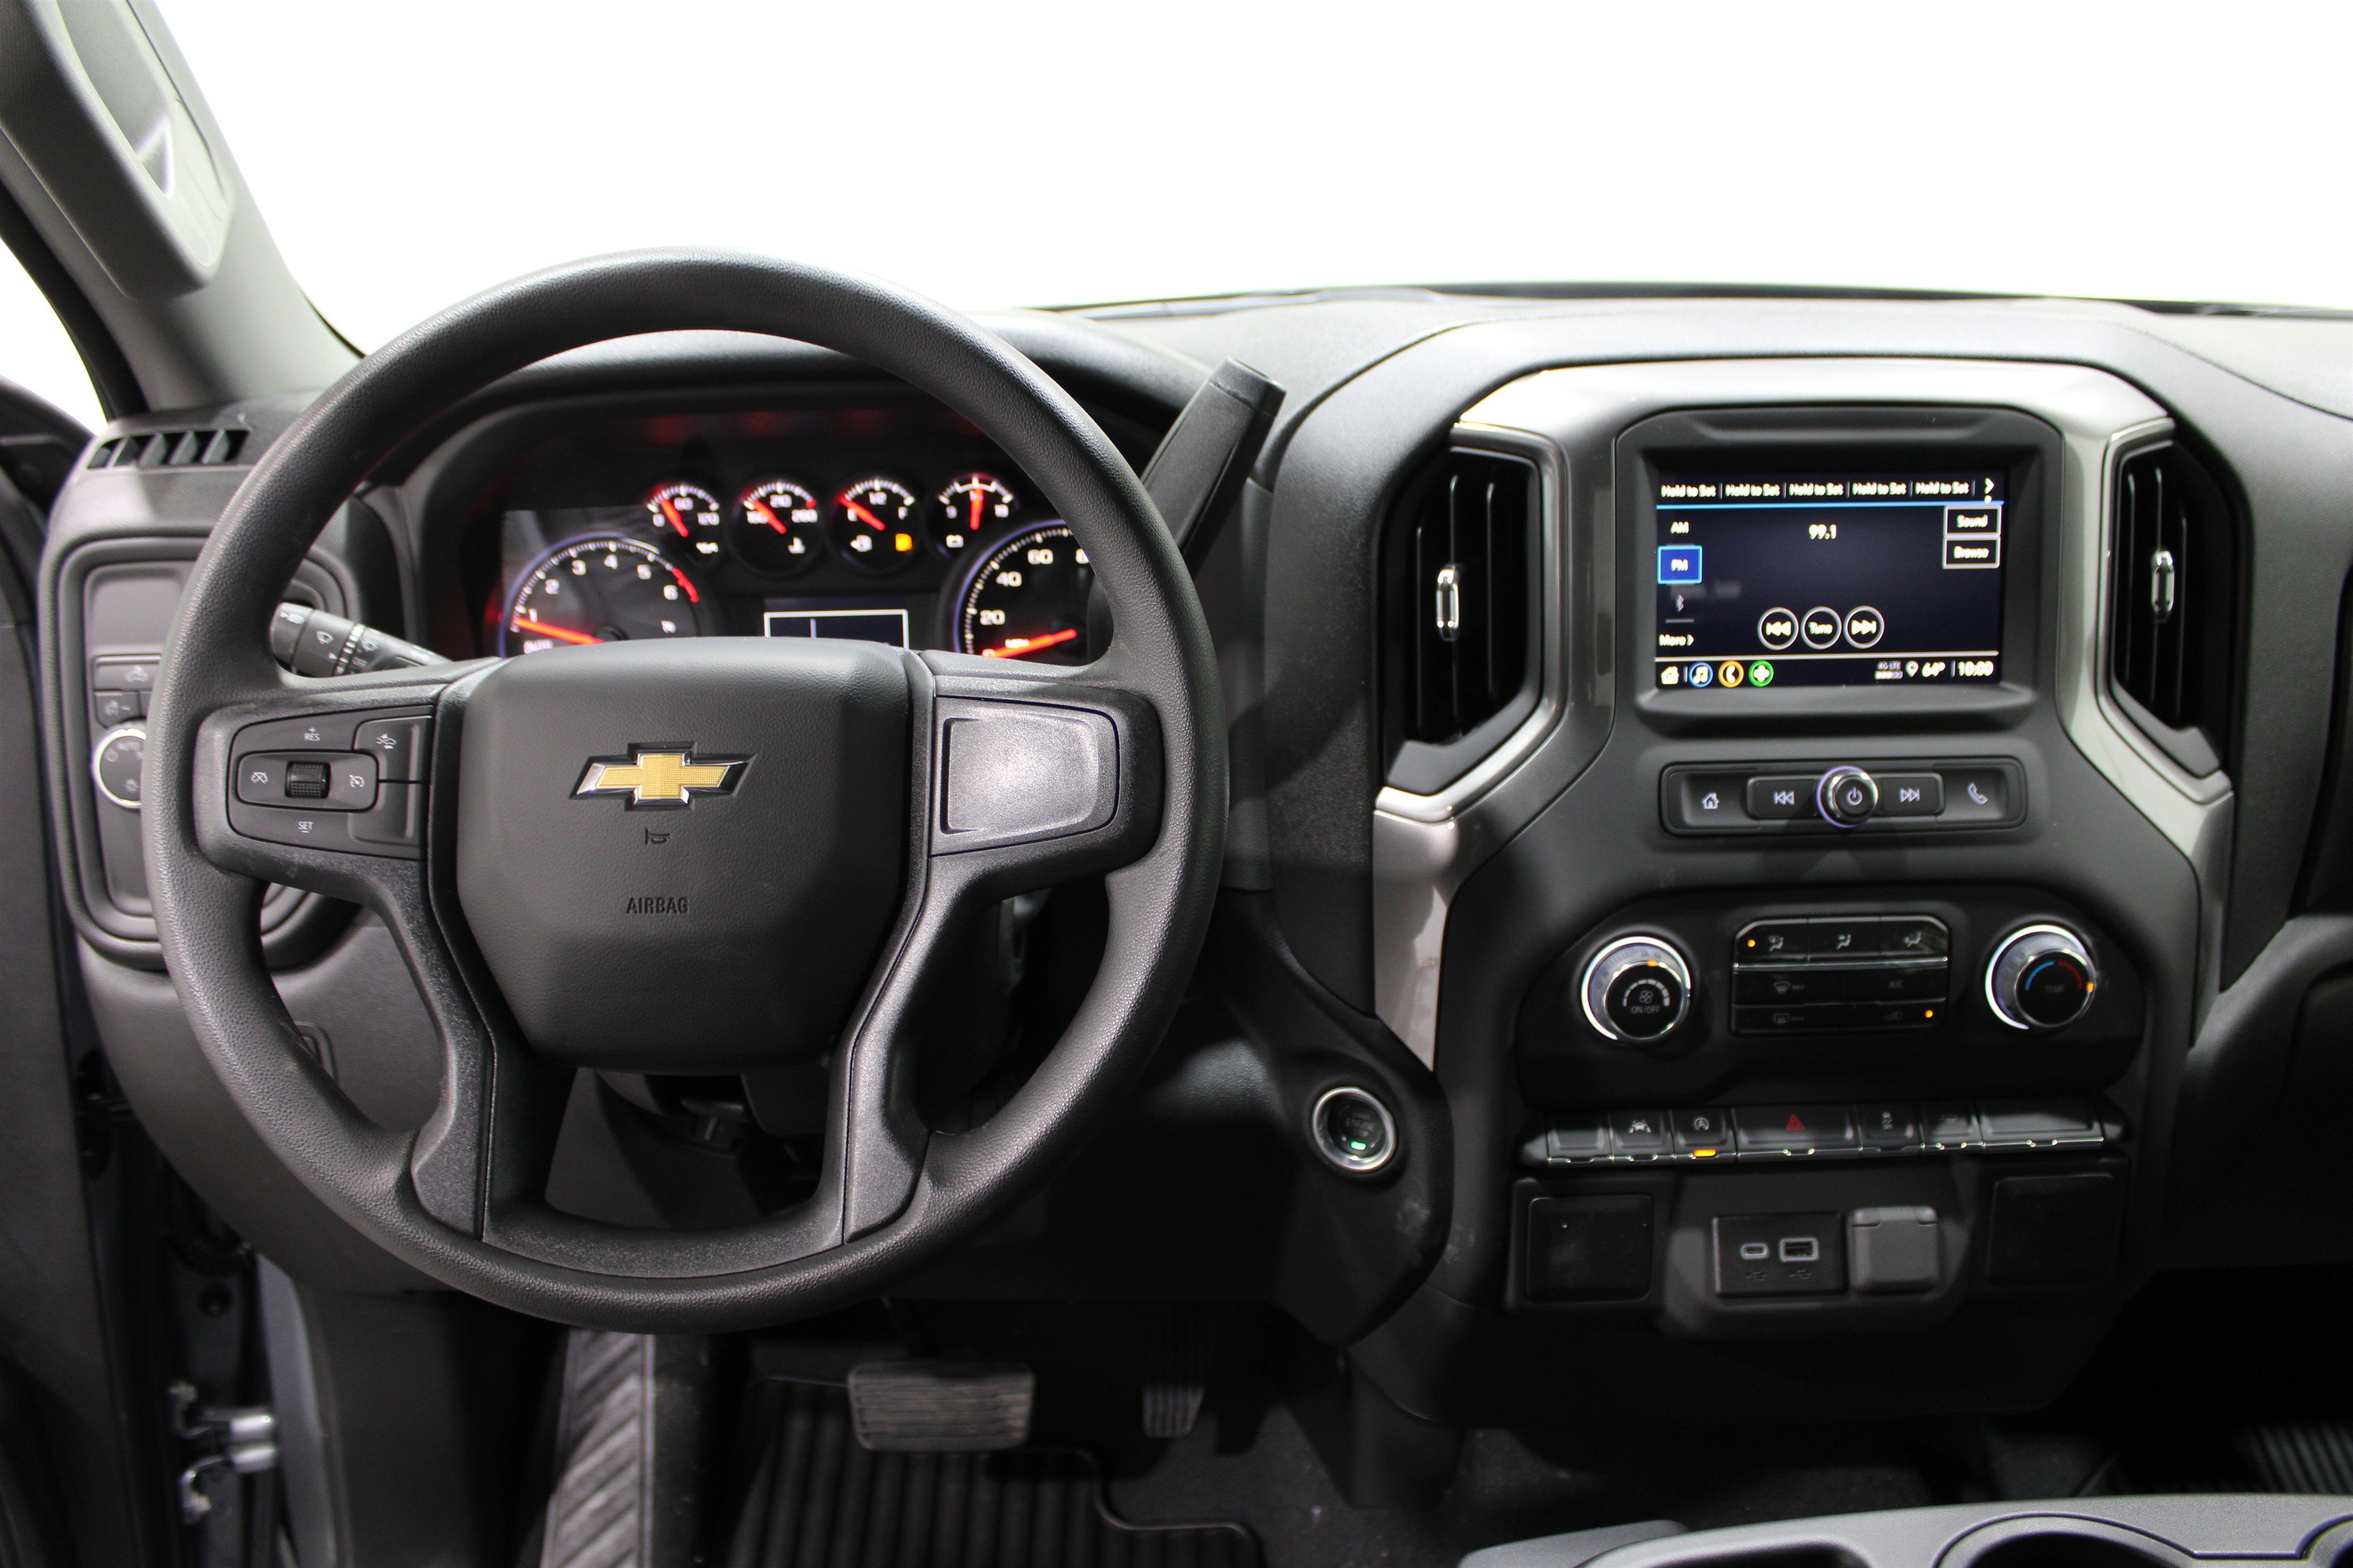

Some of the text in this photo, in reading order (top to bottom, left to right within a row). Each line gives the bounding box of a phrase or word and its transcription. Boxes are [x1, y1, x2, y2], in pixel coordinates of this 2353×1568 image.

[1661, 484, 1716, 497] Hold to Set
[1726, 483, 1780, 497] Hold to Set
[1789, 482, 1843, 496] Hold to Set
[1852, 482, 1907, 496] Hold to Set
[1915, 481, 1969, 495] Hold to Set
[898, 506, 908, 520] F
[1670, 521, 1689, 534] AM
[1957, 514, 1988, 528] Sound
[1808, 524, 1837, 540] 99.1
[1027, 549, 1054, 565] 60
[1075, 549, 1089, 564] 8
[1954, 546, 1989, 559] Browse
[572, 559, 587, 576] 3
[604, 554, 618, 570] 4
[1671, 559, 1688, 571] FM
[637, 564, 652, 580] 5
[996, 571, 1023, 587] 40
[545, 578, 560, 594] 2
[663, 585, 678, 600] 6
[528, 608, 538, 623] 1
[979, 609, 1005, 625] 20
[1808, 621, 1833, 635] Tune
[1659, 634, 1687, 647] More
[1958, 661, 1994, 677] 10:00
[304, 732, 321, 741] RES
[298, 821, 313, 831] SET
[626, 897, 689, 914] AIRBAG
[1889, 980, 1904, 989] A/C
[1631, 1006, 1660, 1015] ON/OFF
